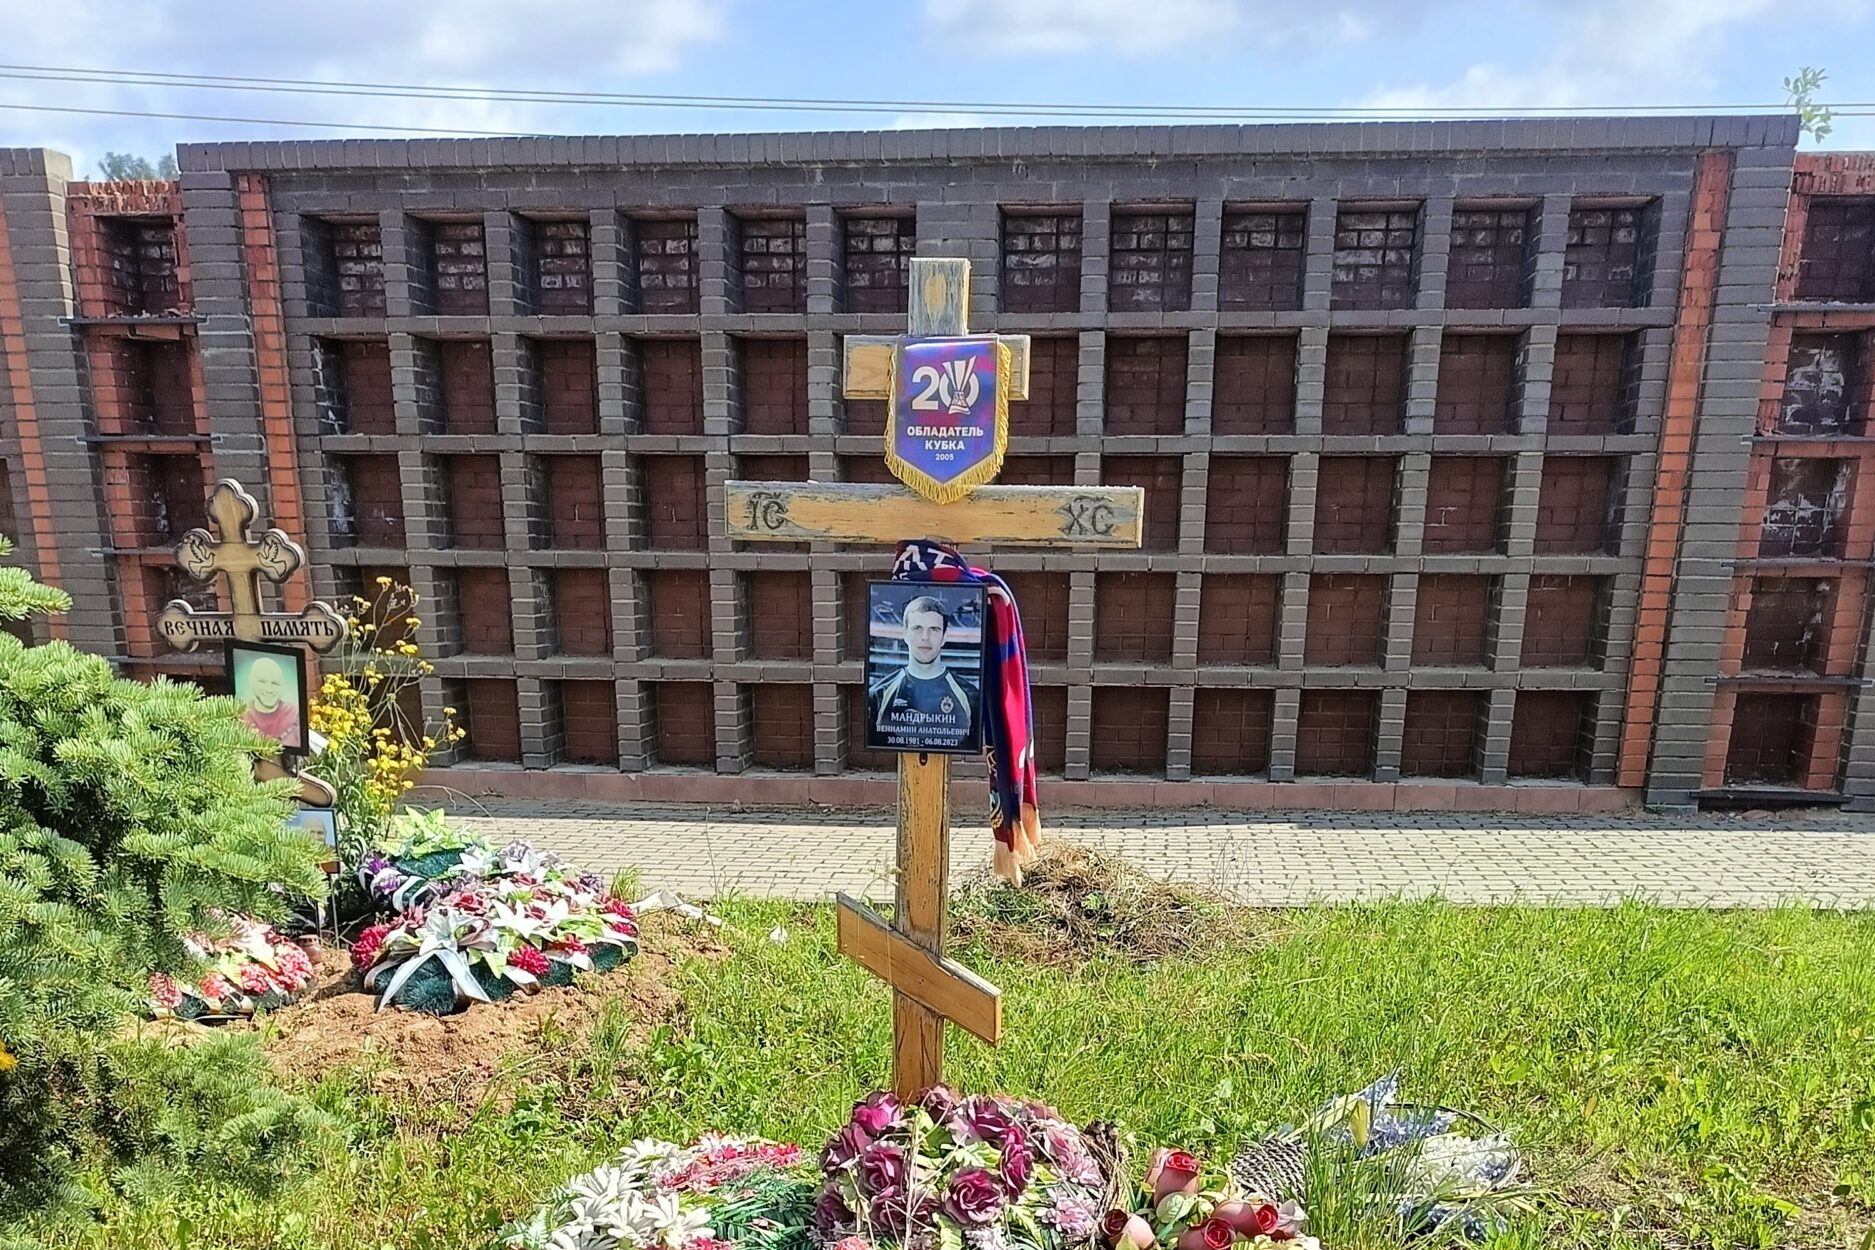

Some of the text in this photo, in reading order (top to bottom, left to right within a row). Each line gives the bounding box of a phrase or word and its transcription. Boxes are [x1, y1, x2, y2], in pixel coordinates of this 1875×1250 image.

[906, 425, 984, 438] ОБЛАДАТЕЛЬ
[924, 439, 965, 450] КУБКА
[935, 453, 954, 461] 2005
[164, 620, 334, 637] ВЕЧНАЯ ПАМЯТЬ
[890, 711, 956, 724] МАНДРЫКИН
[876, 725, 970, 736] ВЕНИАМИН АНАТОЛЬЕВИЧ
[924, 738, 958, 747] 06.08.2023
